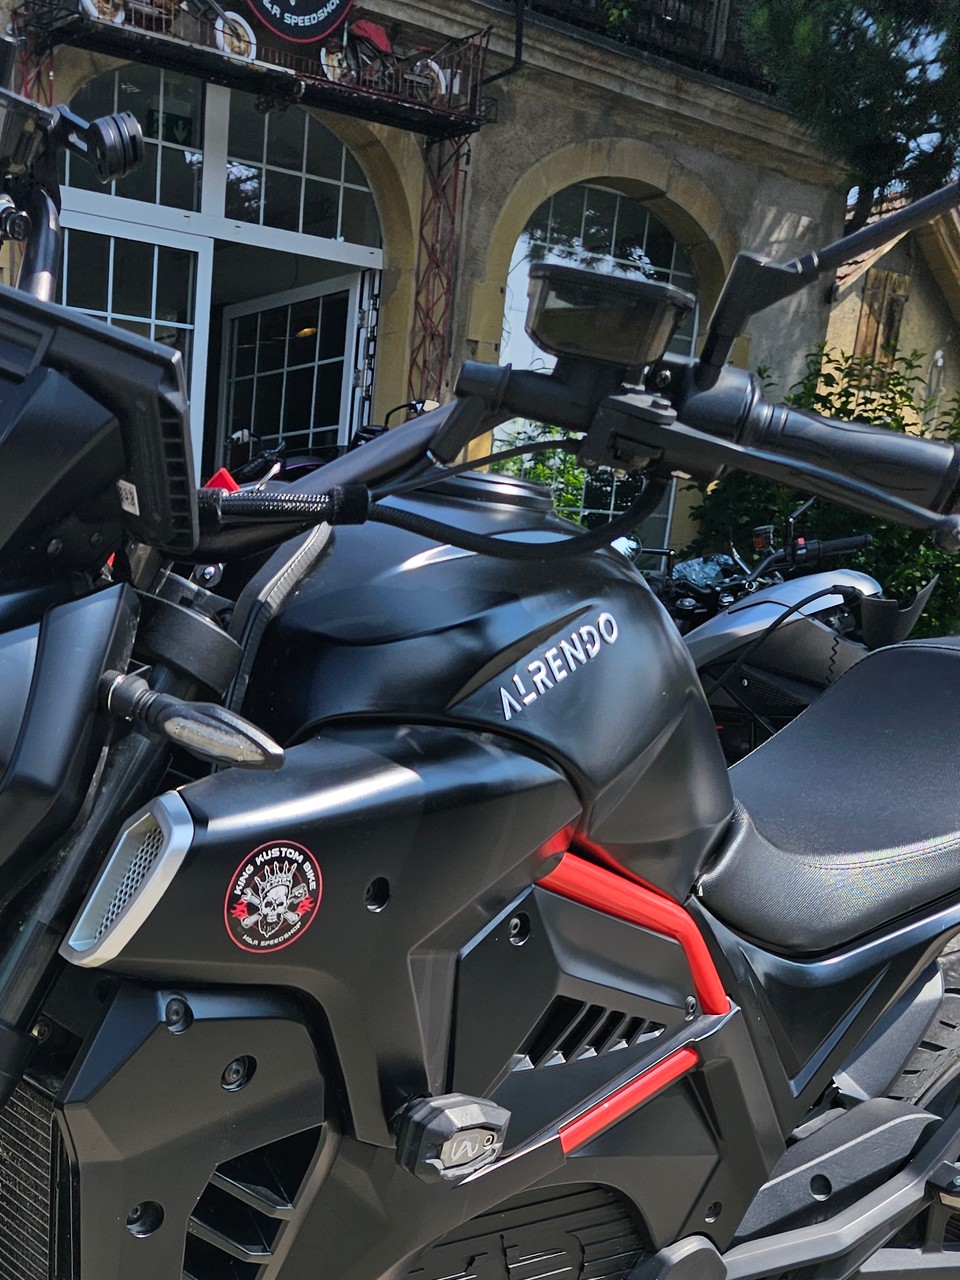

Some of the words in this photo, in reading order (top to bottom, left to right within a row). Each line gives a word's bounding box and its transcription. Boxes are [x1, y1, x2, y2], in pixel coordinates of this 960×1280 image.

[499, 612, 619, 721] ALRENDO
[234, 864, 254, 895] KING
[255, 847, 304, 866] KUSTOM
[303, 861, 316, 891] BIKE
[260, 921, 301, 947] SPEEDSHOP
